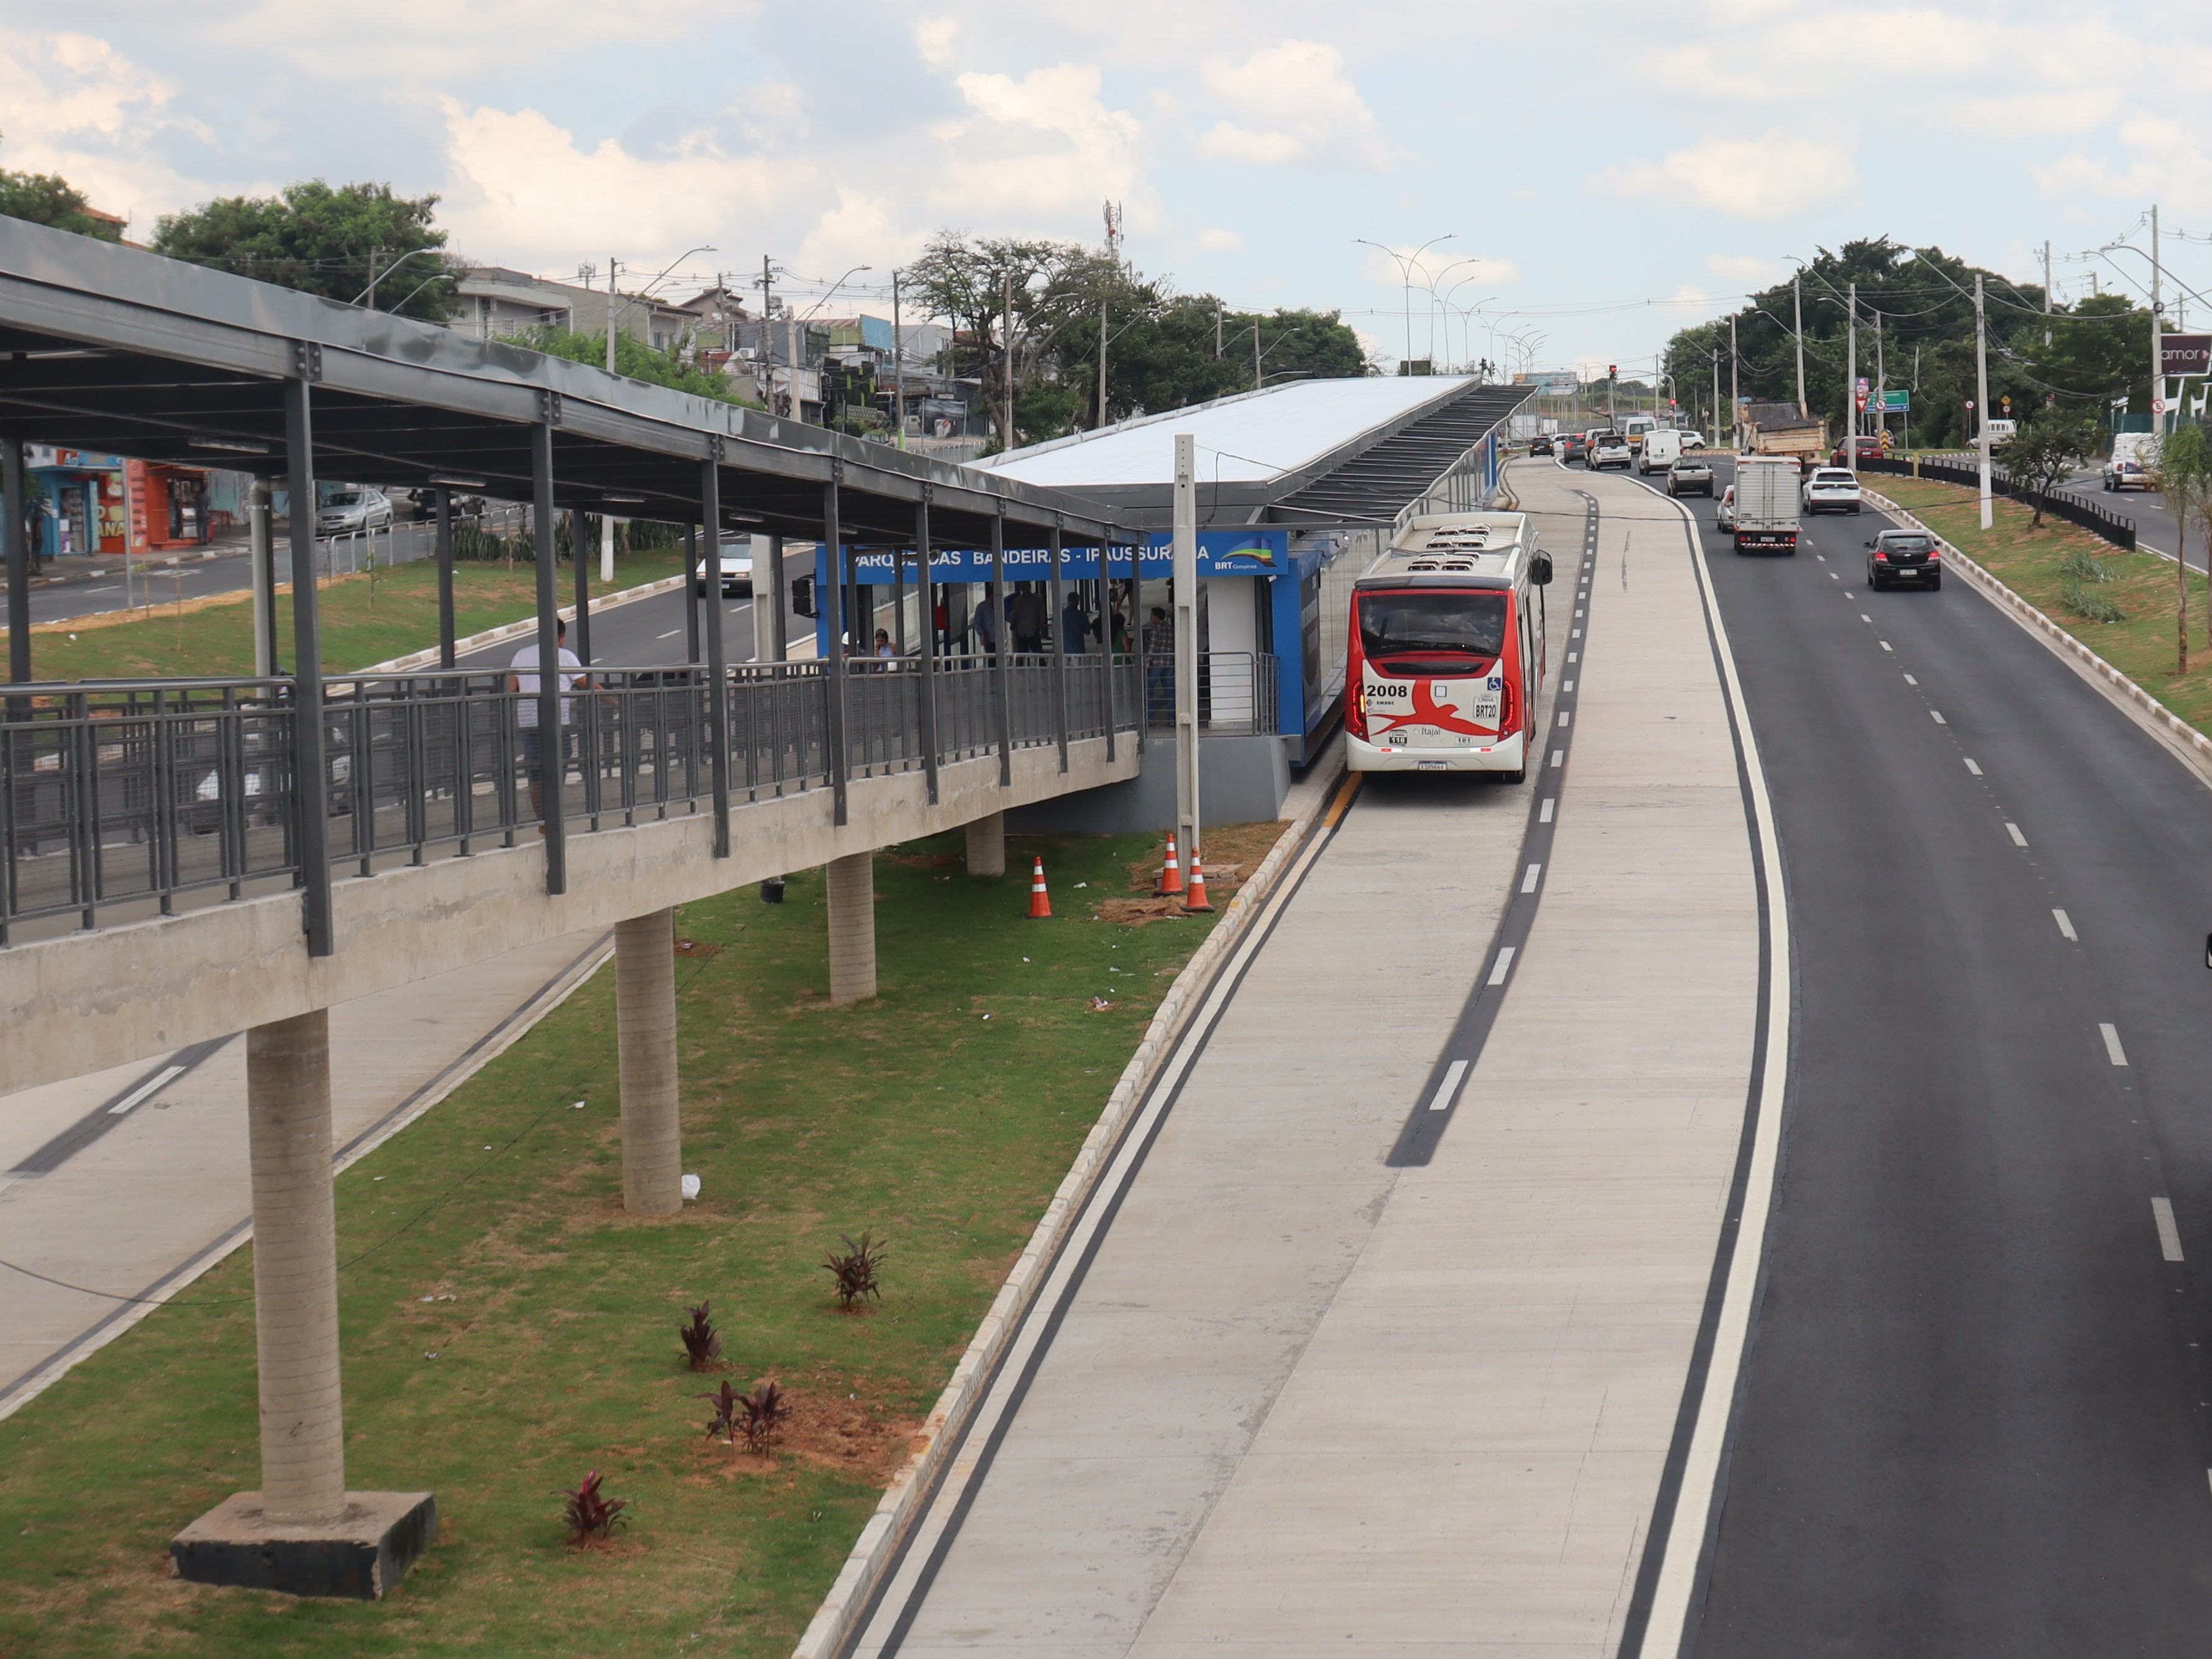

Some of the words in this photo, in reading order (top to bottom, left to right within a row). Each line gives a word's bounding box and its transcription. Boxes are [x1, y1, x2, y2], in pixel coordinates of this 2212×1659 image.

[2162, 349, 2200, 360] amor
[973, 548, 1071, 565] BANDEIRS
[1367, 685, 1408, 697] 2008
[1476, 704, 1496, 717] BRT20
